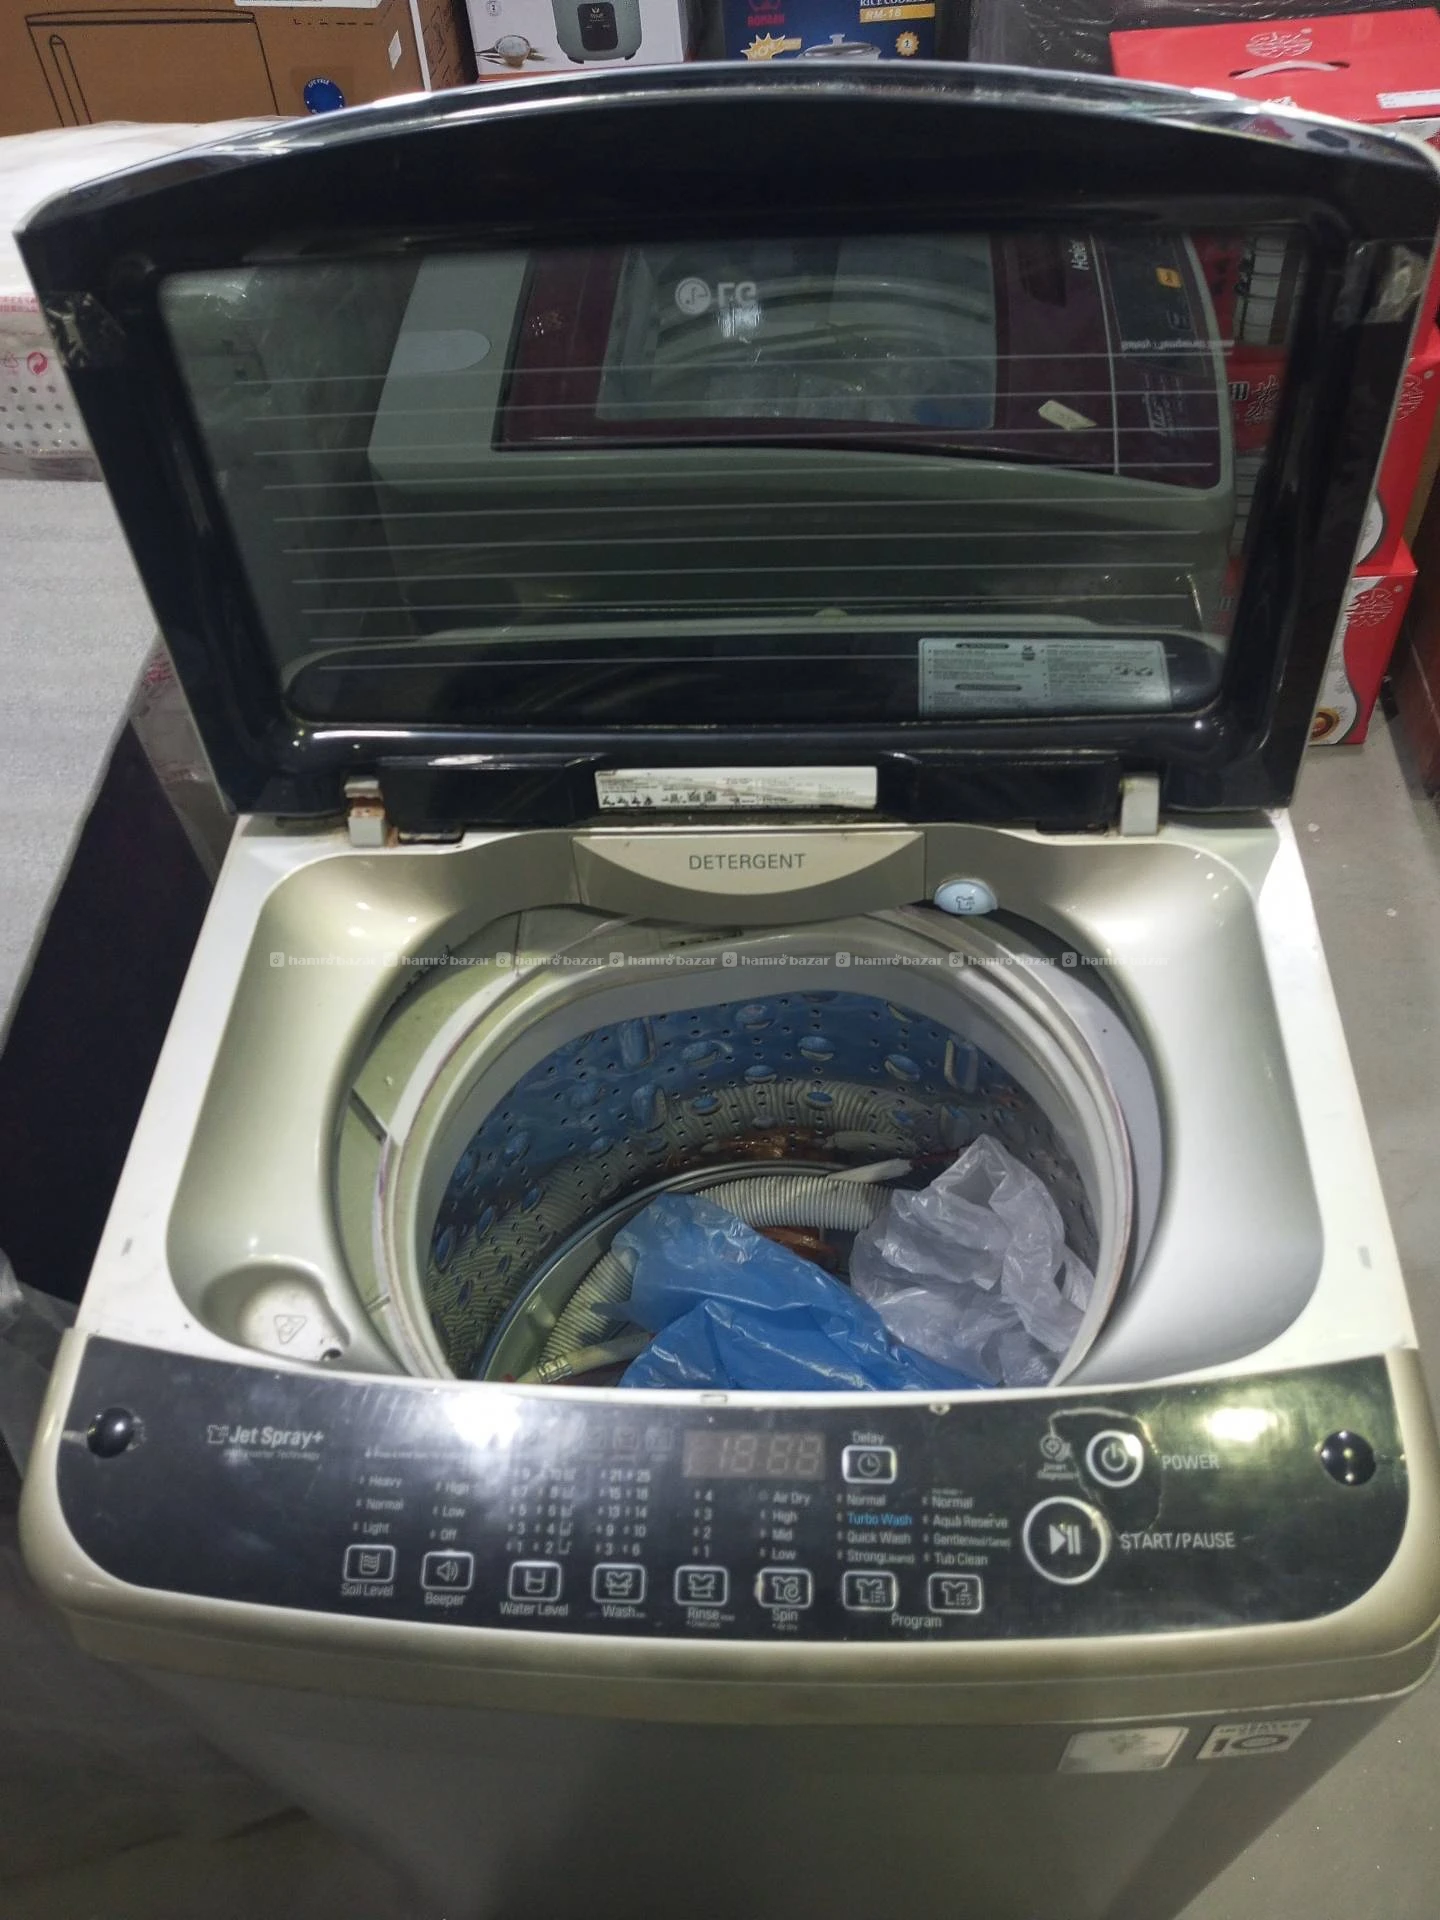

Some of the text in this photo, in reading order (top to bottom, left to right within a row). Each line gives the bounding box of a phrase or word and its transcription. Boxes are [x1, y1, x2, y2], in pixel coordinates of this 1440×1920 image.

[688, 854, 806, 870] DETERGENT
[229, 1425, 324, 1449] Jet Spray+
[852, 1431, 884, 1445] Delay
[1161, 1454, 1220, 1470] POWER
[368, 1475, 402, 1488] Heavy
[445, 1480, 470, 1495] High
[366, 1498, 403, 1511] Normal
[847, 1494, 886, 1506] Normal
[931, 1497, 974, 1509] Normal
[442, 1505, 465, 1517] Low
[772, 1509, 797, 1524] High
[848, 1512, 912, 1527] Turbo Wash
[362, 1521, 389, 1535] Light
[440, 1527, 457, 1541] Off
[847, 1531, 911, 1545] Quick Wash
[1119, 1532, 1236, 1550] START/PAUSE
[771, 1546, 796, 1560] Low
[935, 1552, 989, 1566] Tub Clean
[341, 1584, 394, 1597] Soil Level
[424, 1592, 466, 1607] Beeper
[500, 1602, 569, 1616] Water Level
[603, 1605, 636, 1619] Wash
[687, 1607, 721, 1620] Rinse
[772, 1608, 799, 1624] Spin
[891, 1614, 943, 1631] Program
